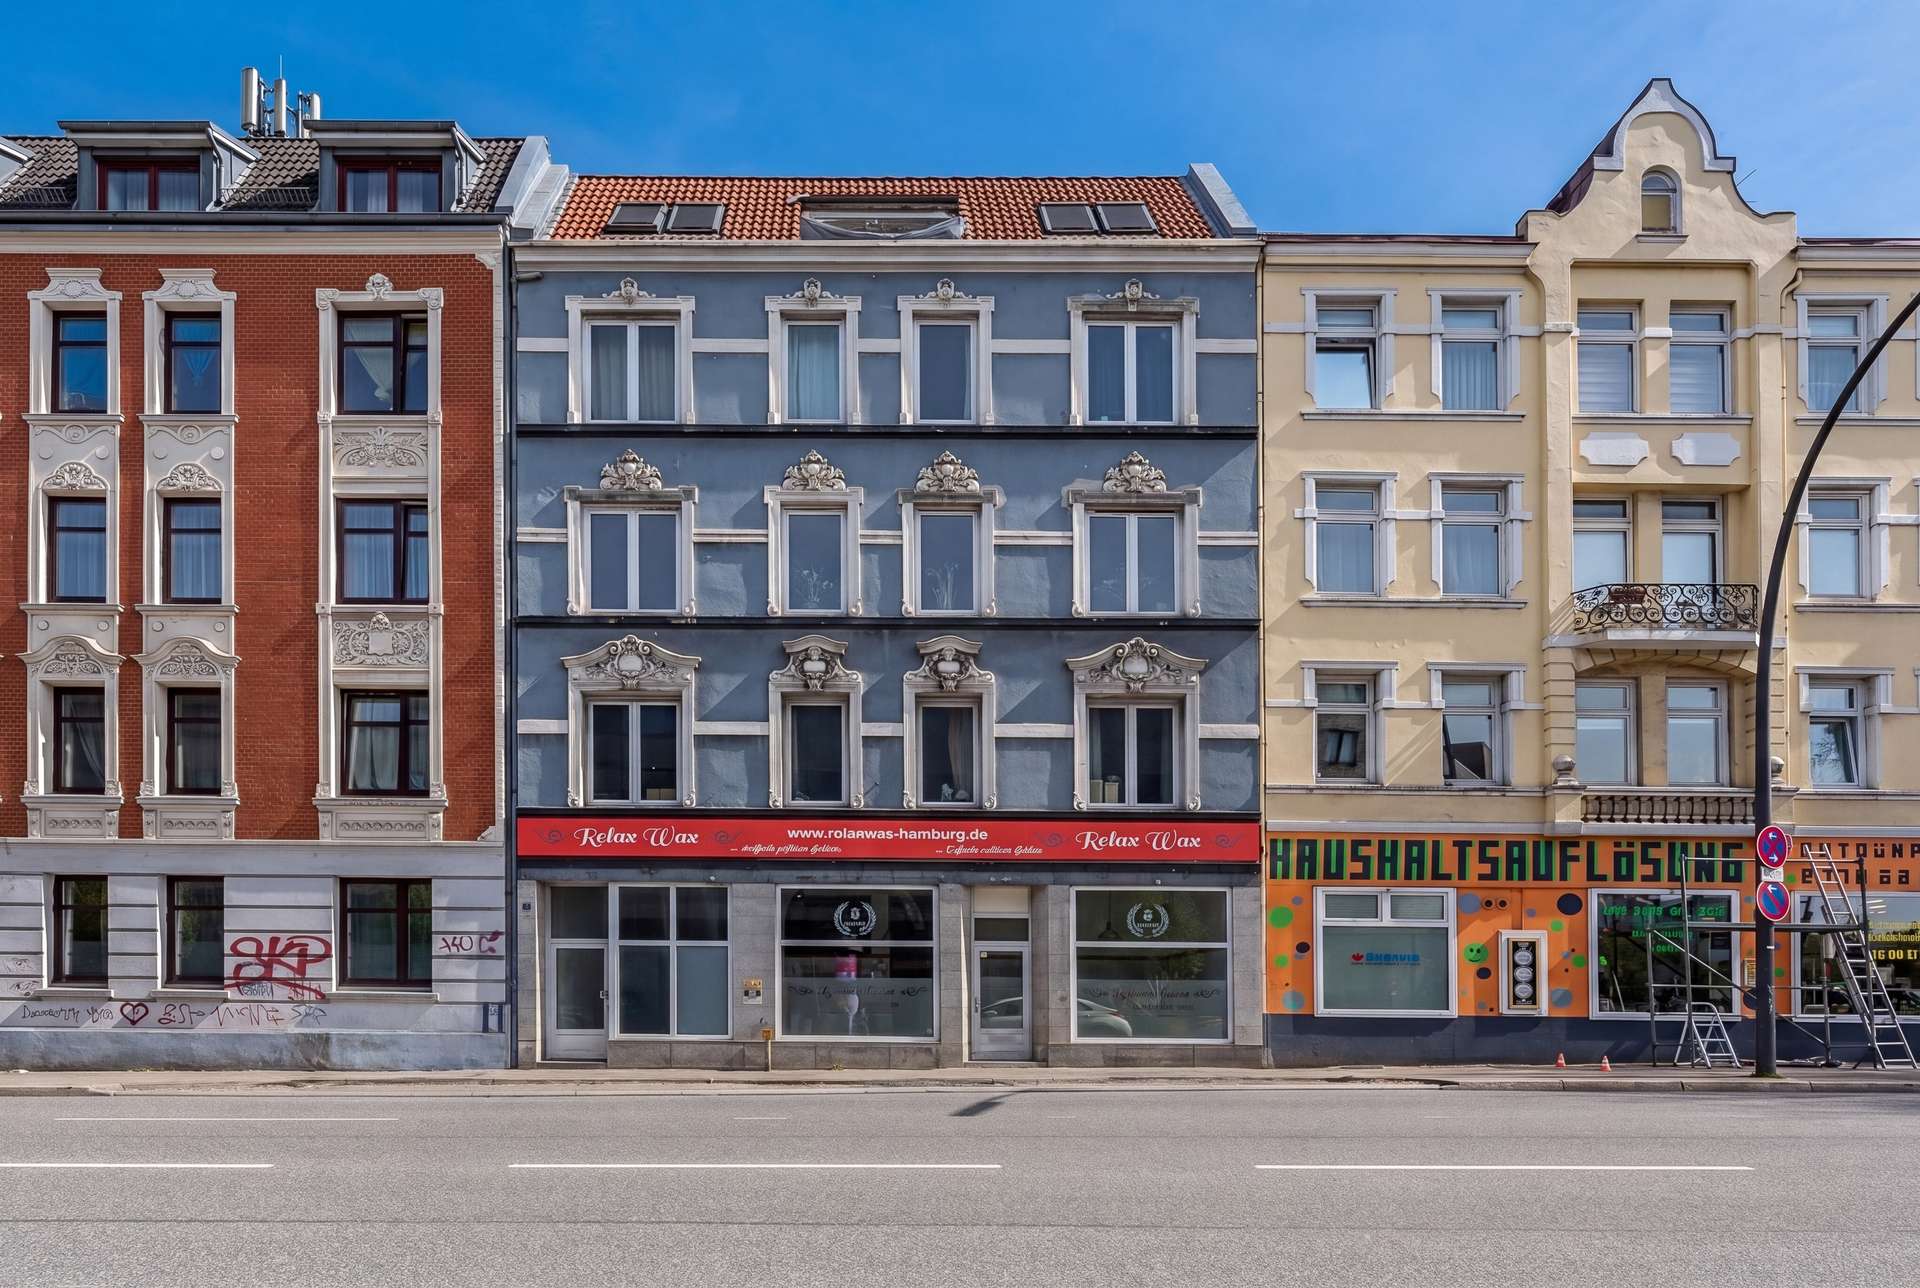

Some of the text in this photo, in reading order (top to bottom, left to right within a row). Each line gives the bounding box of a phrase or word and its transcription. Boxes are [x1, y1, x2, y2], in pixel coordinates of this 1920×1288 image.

[574, 825, 699, 848] Relax Wax
[1075, 829, 1200, 851] Relax Wax
[1270, 839, 1744, 883] HAUSHALTSAUFLÖSUNG
